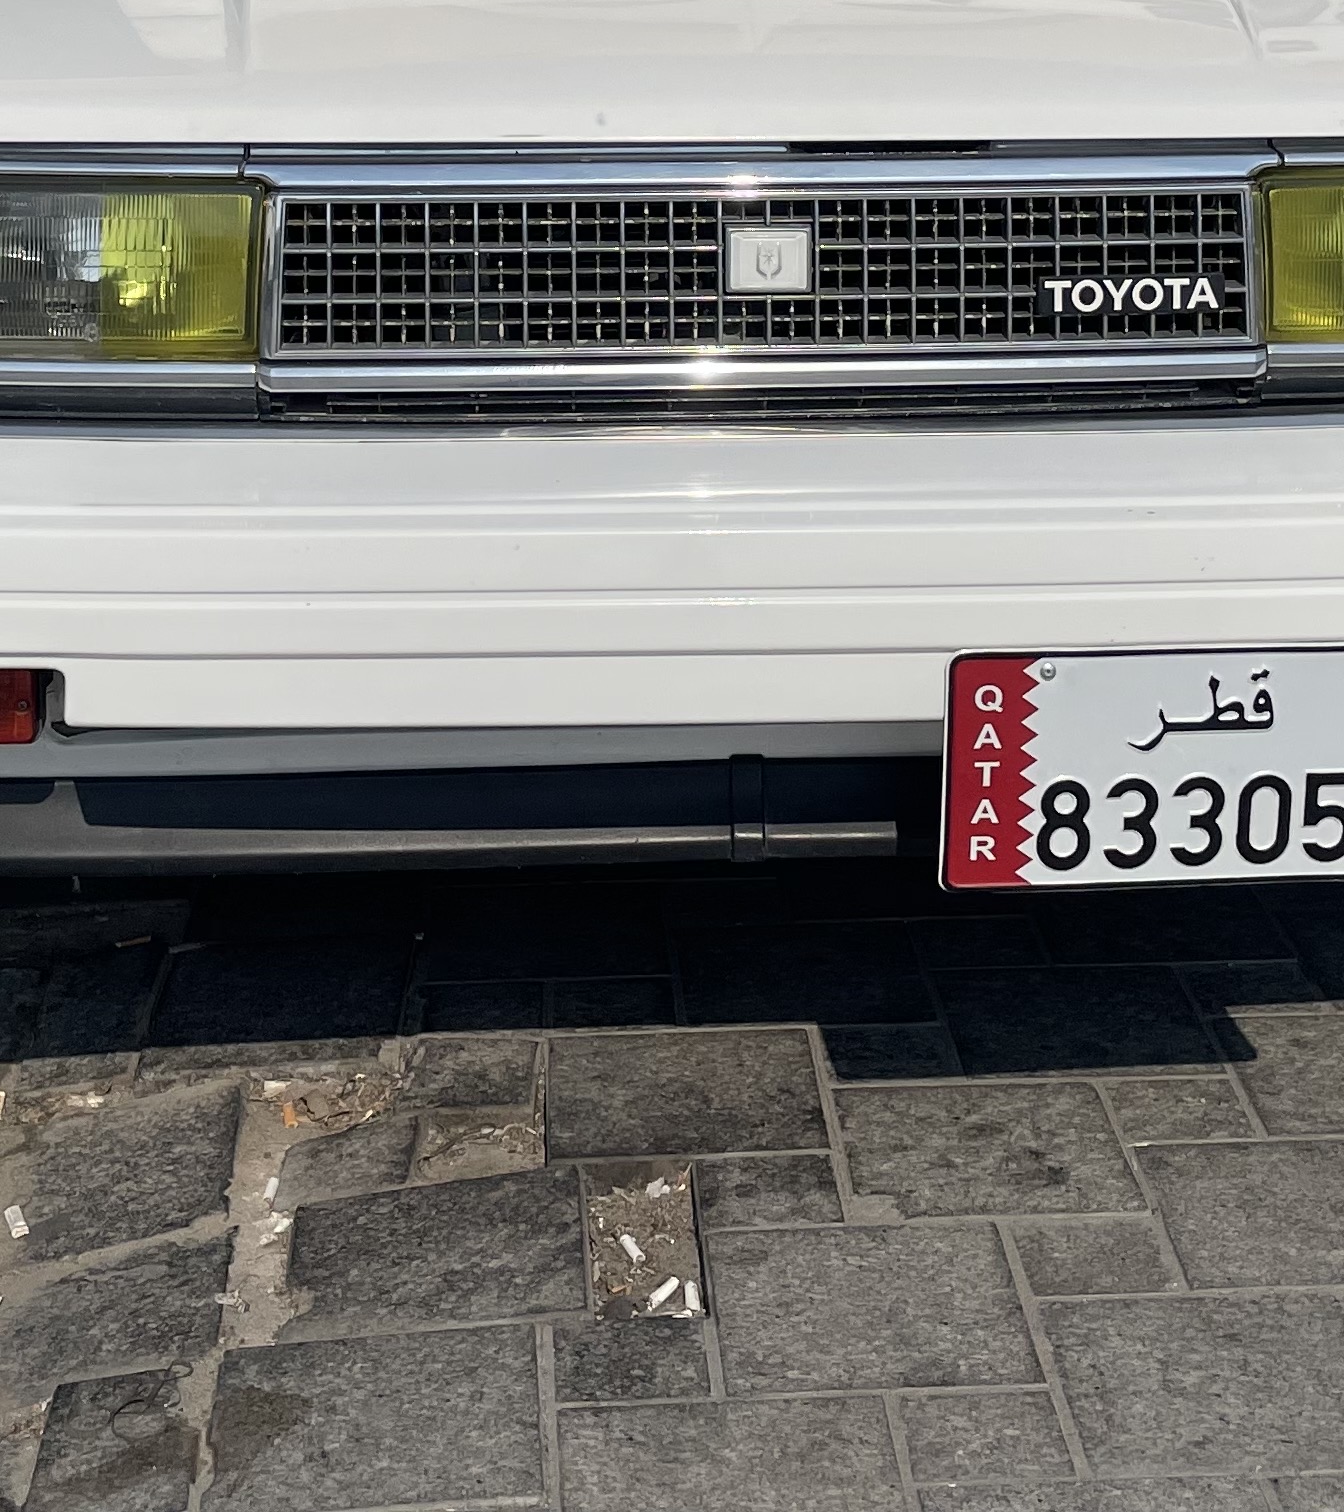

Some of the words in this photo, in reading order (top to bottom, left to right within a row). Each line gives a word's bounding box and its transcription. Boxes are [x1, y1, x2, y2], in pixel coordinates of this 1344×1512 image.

[1044, 276, 1220, 314] TOYOTA
[1127, 667, 1275, 752] قطر
[968, 684, 1005, 863] QATAR
